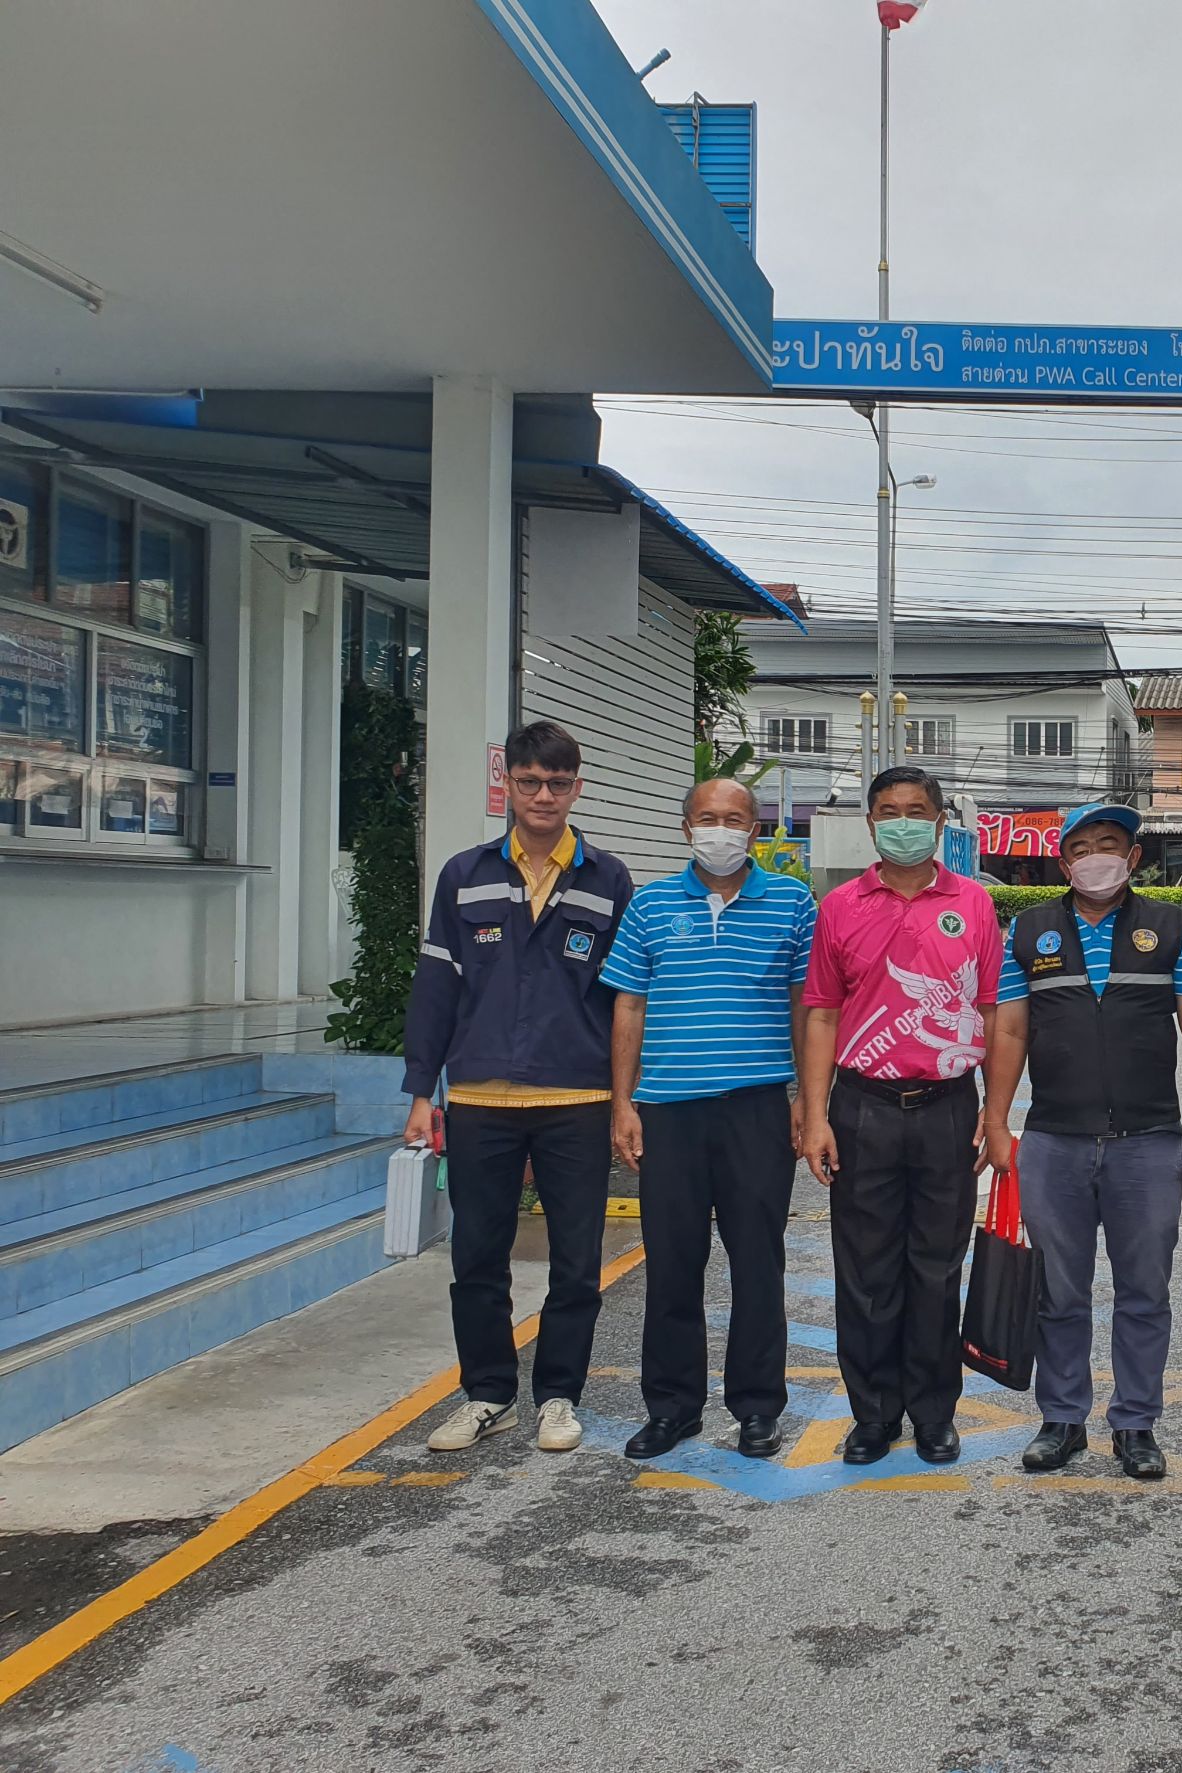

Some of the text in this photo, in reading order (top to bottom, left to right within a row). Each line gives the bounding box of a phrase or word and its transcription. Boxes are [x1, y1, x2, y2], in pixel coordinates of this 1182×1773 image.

[772, 326, 945, 373] ะปาทันใจ
[961, 330, 1007, 353] ติดต่อ
[1014, 334, 1149, 357] กปภ.สาขาระยอง
[961, 362, 1028, 384] สายด่วน
[1035, 366, 1074, 384] PWA
[1082, 367, 1116, 386] Call
[473, 932, 502, 944] 1662
[894, 1009, 920, 1036] OF
[919, 972, 964, 1017] PUBLC
